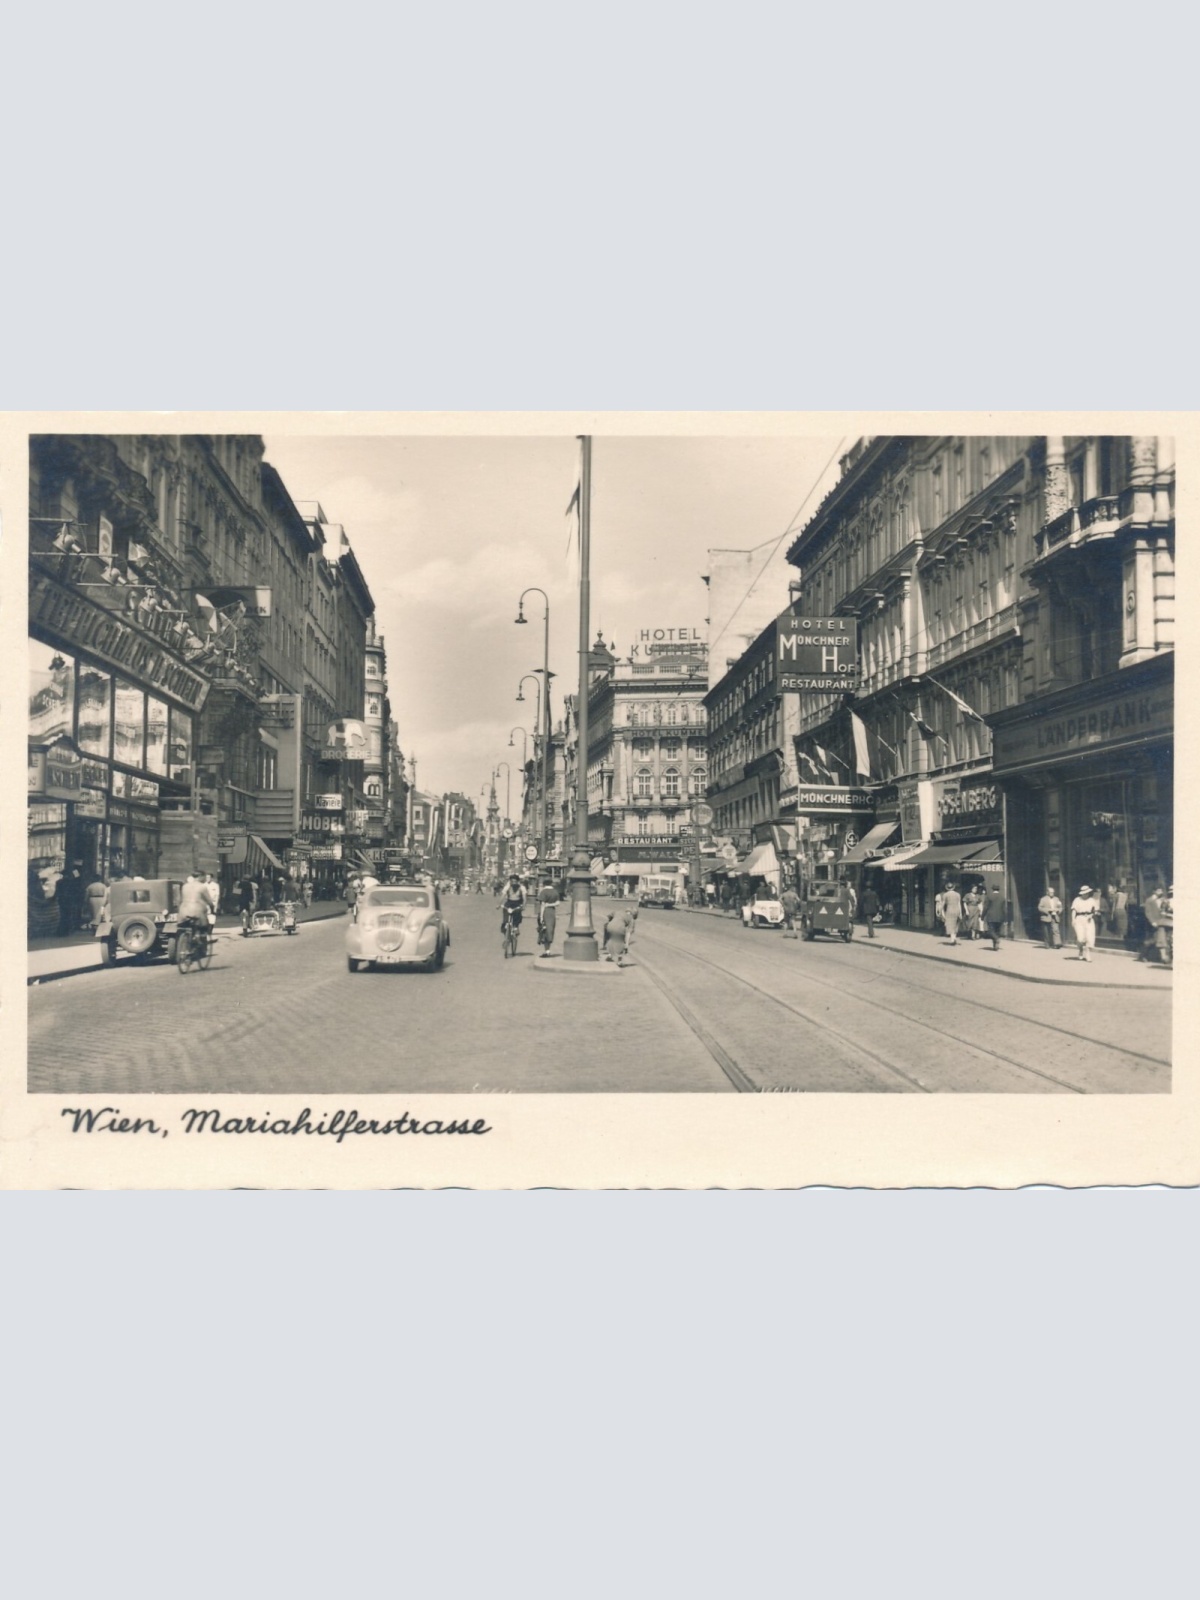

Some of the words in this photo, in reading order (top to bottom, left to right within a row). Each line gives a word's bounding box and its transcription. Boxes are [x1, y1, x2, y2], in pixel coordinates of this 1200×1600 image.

[791, 620, 846, 630] HOTEL
[640, 628, 702, 641] HOTEL
[822, 646, 855, 673] HOF
[781, 679, 854, 688] RESTAURANT
[321, 750, 371, 760] DROGERIE
[302, 813, 345, 831] MÖBEL
[618, 837, 673, 845] RESTAURANT
